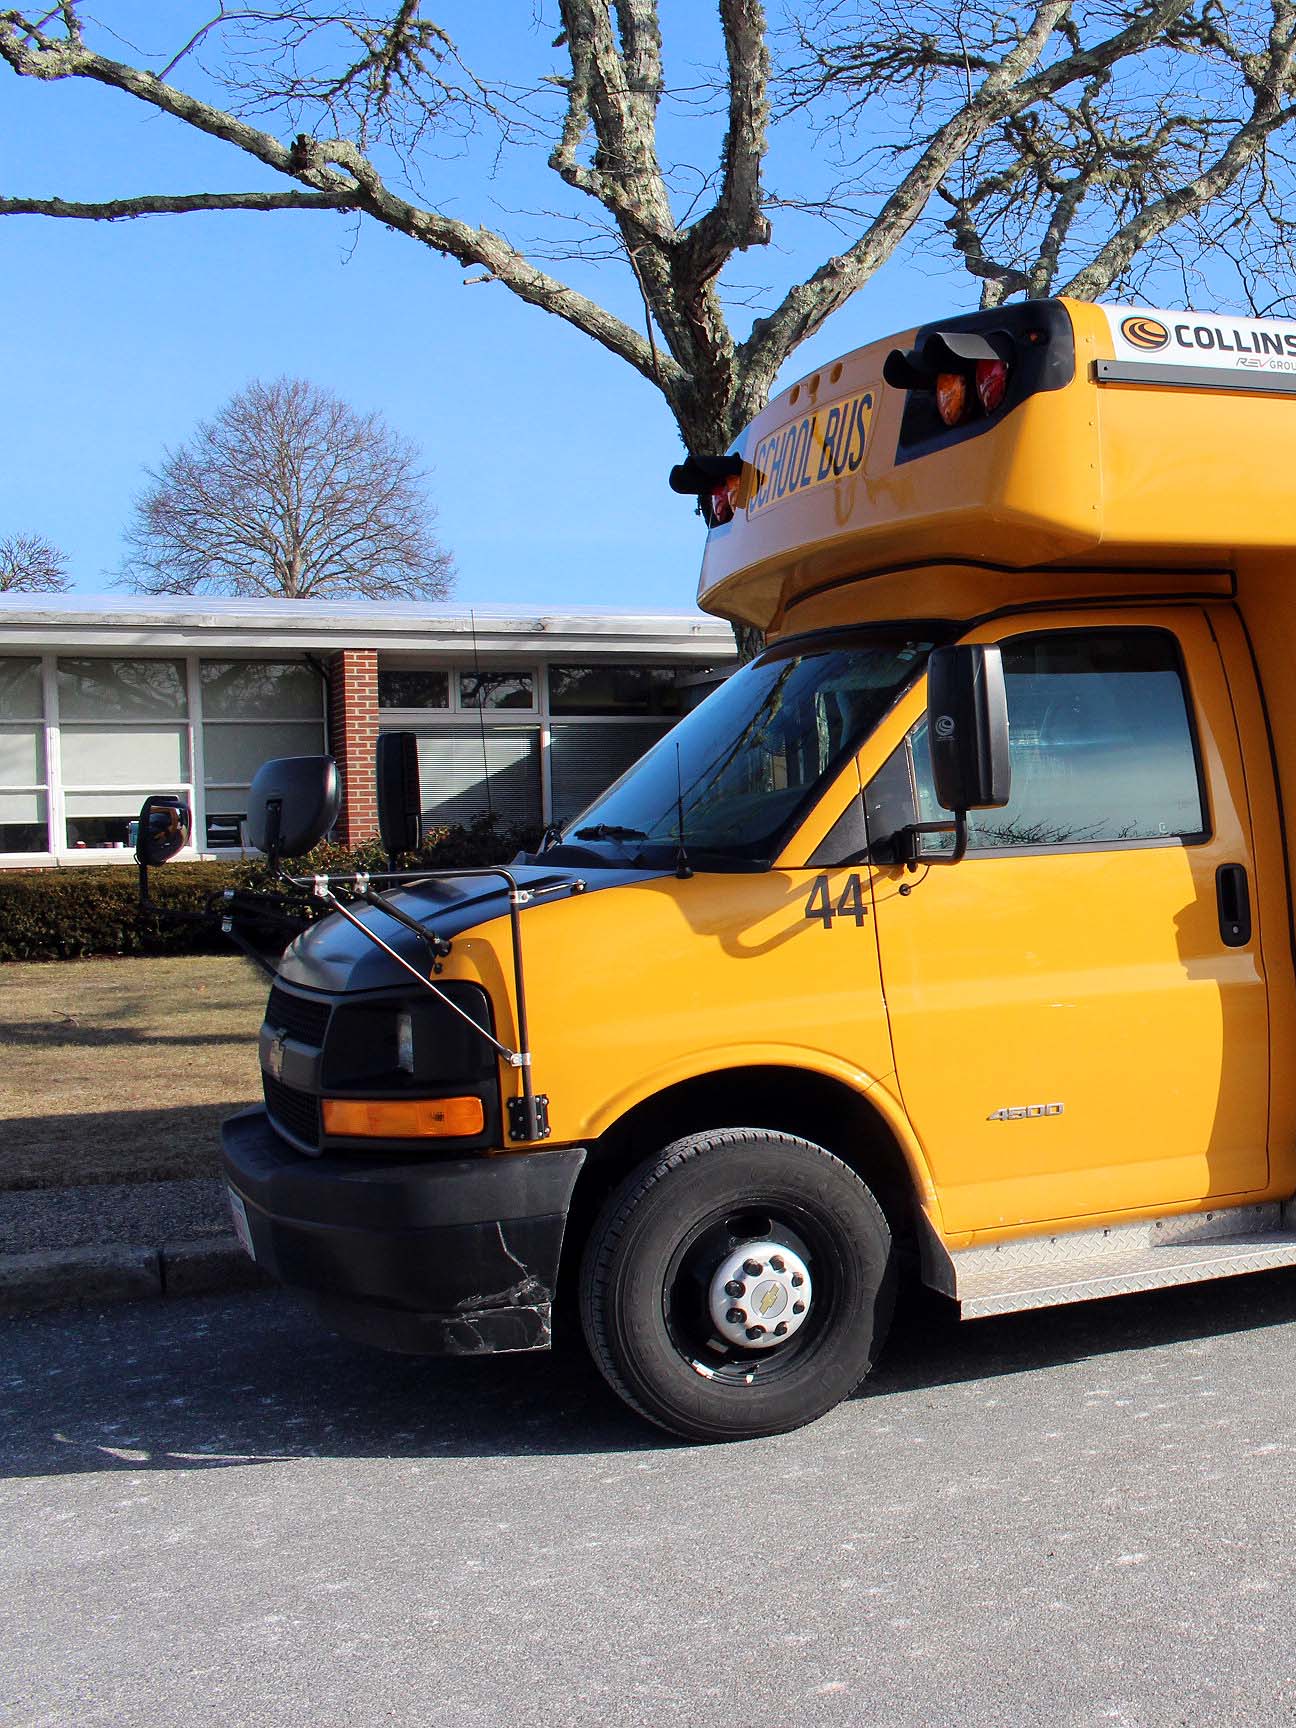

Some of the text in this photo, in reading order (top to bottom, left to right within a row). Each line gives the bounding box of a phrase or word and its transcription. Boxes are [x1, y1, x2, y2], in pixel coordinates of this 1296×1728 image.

[750, 393, 873, 513] SCHOOL BUS
[805, 873, 868, 929] 44
[986, 1102, 1064, 1121] 4500
